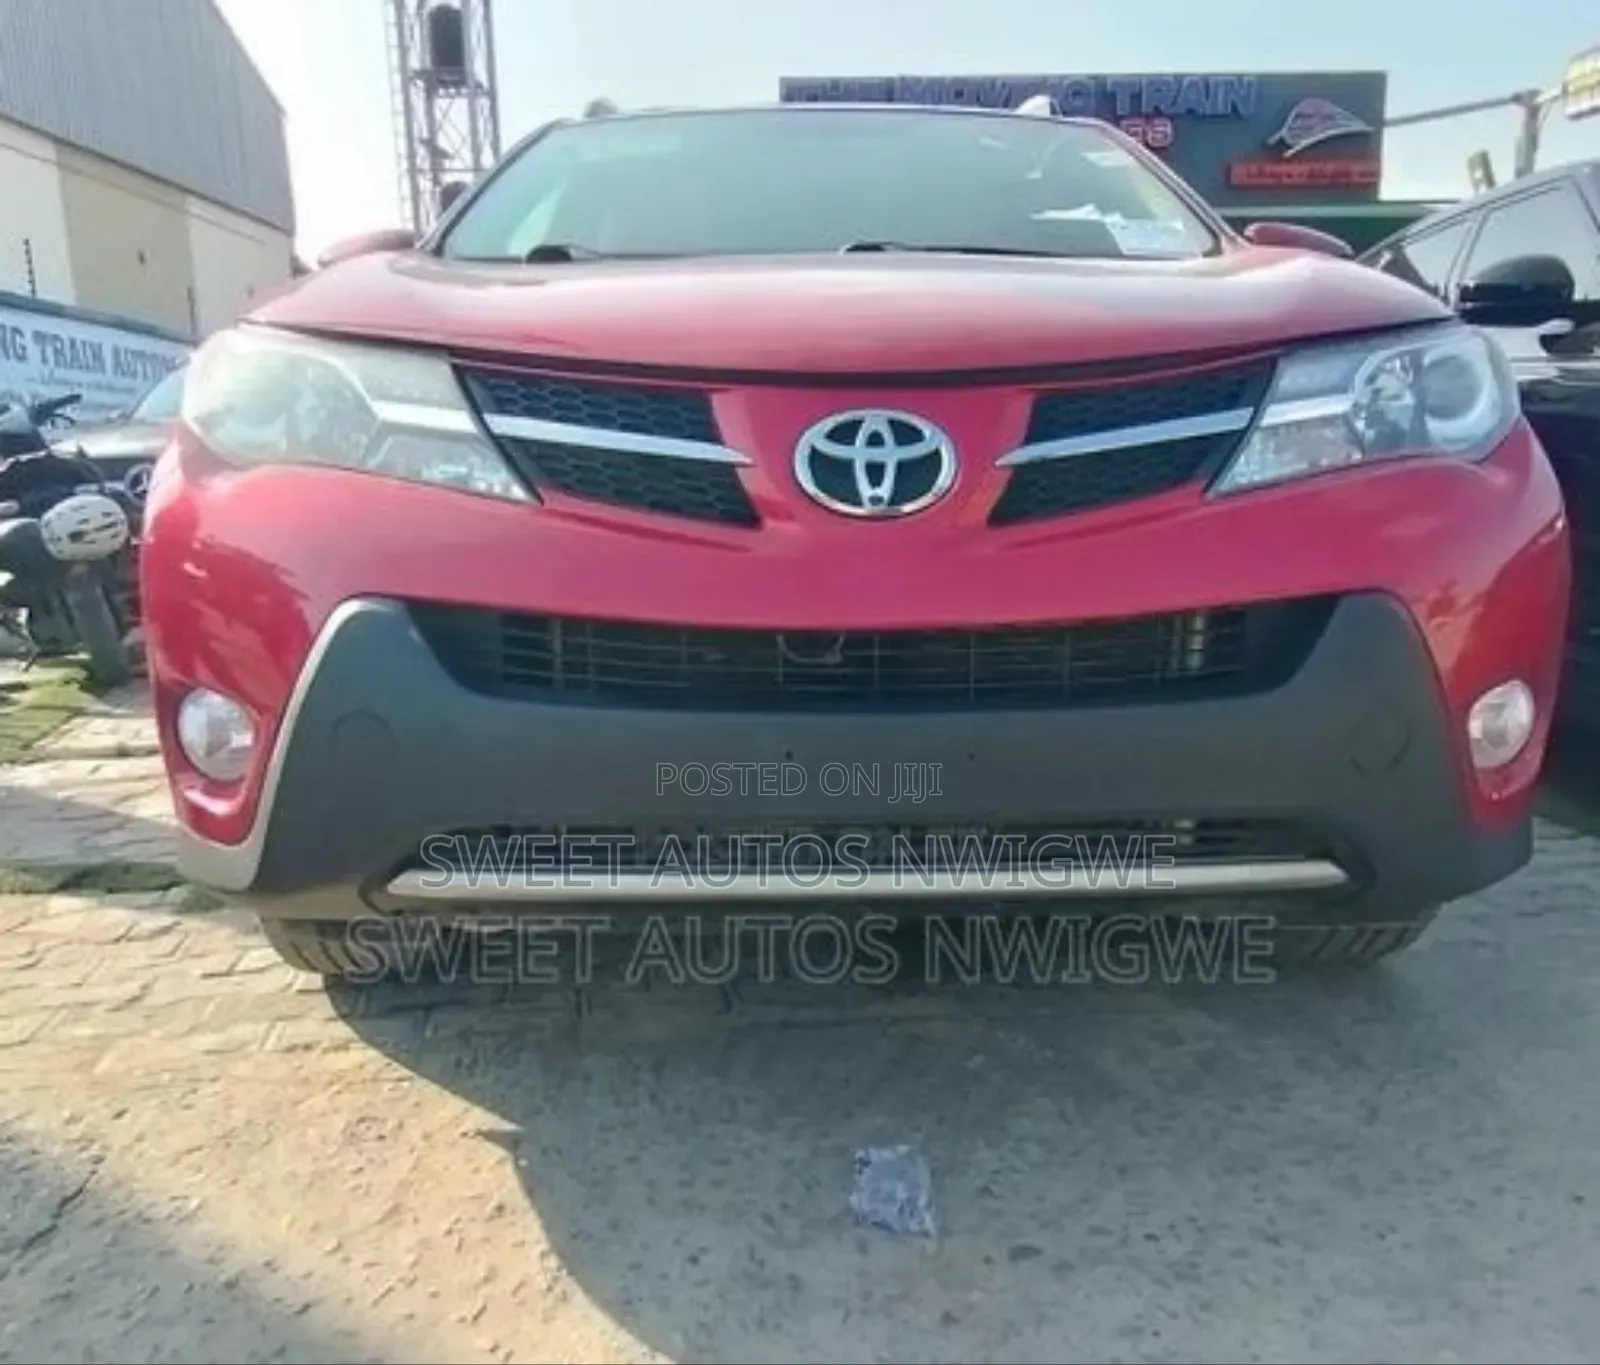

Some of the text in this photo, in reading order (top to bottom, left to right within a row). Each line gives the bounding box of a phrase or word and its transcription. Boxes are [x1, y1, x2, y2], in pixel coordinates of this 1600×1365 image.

[895, 75, 1097, 114] MOVG
[1106, 74, 1258, 116] TRAIN
[32, 329, 106, 374] TRAIN
